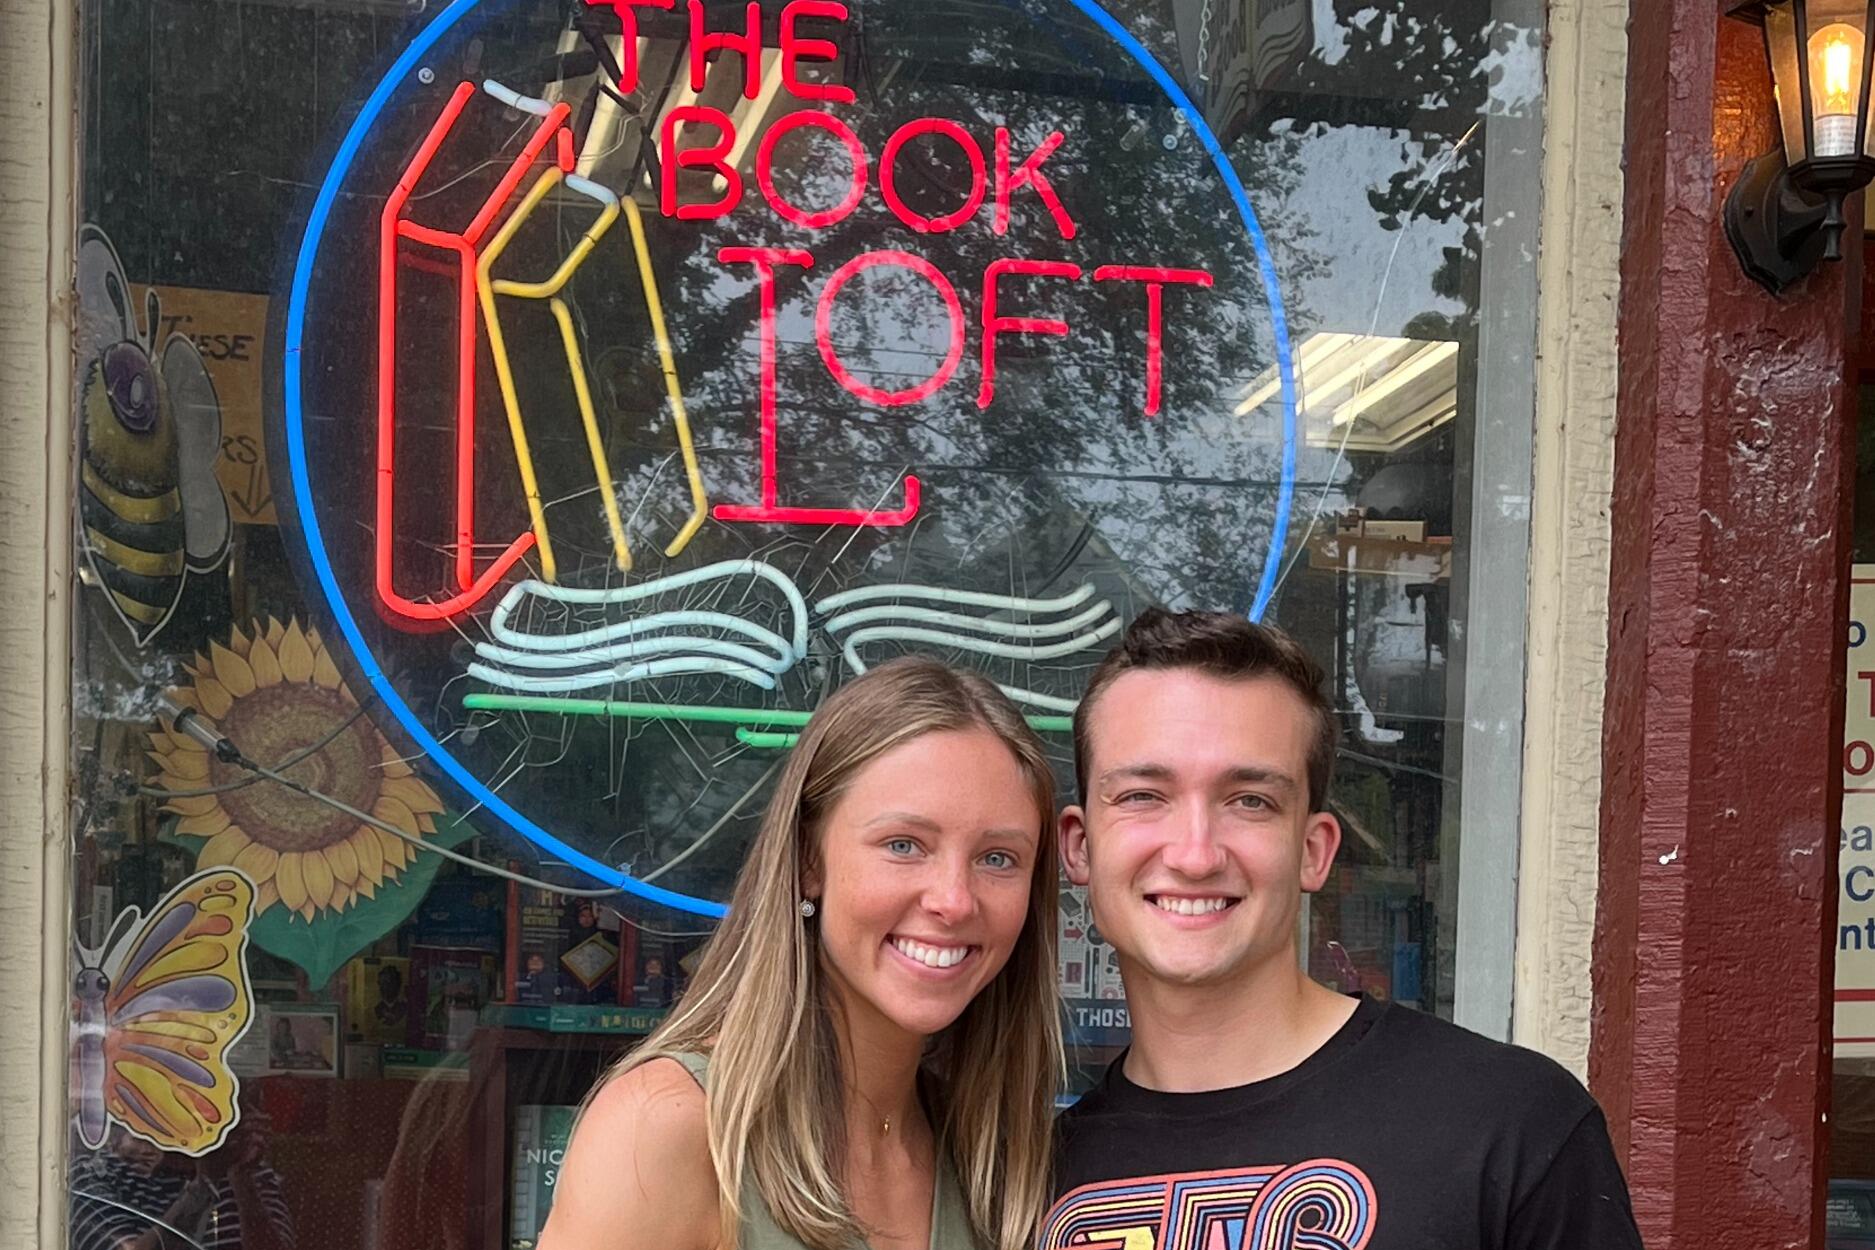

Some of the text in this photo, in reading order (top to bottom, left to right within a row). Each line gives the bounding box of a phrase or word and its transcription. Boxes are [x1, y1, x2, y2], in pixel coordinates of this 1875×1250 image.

[584, 0, 856, 105] THE
[660, 105, 1076, 240] BOOK
[161, 314, 255, 362] TESE
[712, 246, 1213, 527] LOFT
